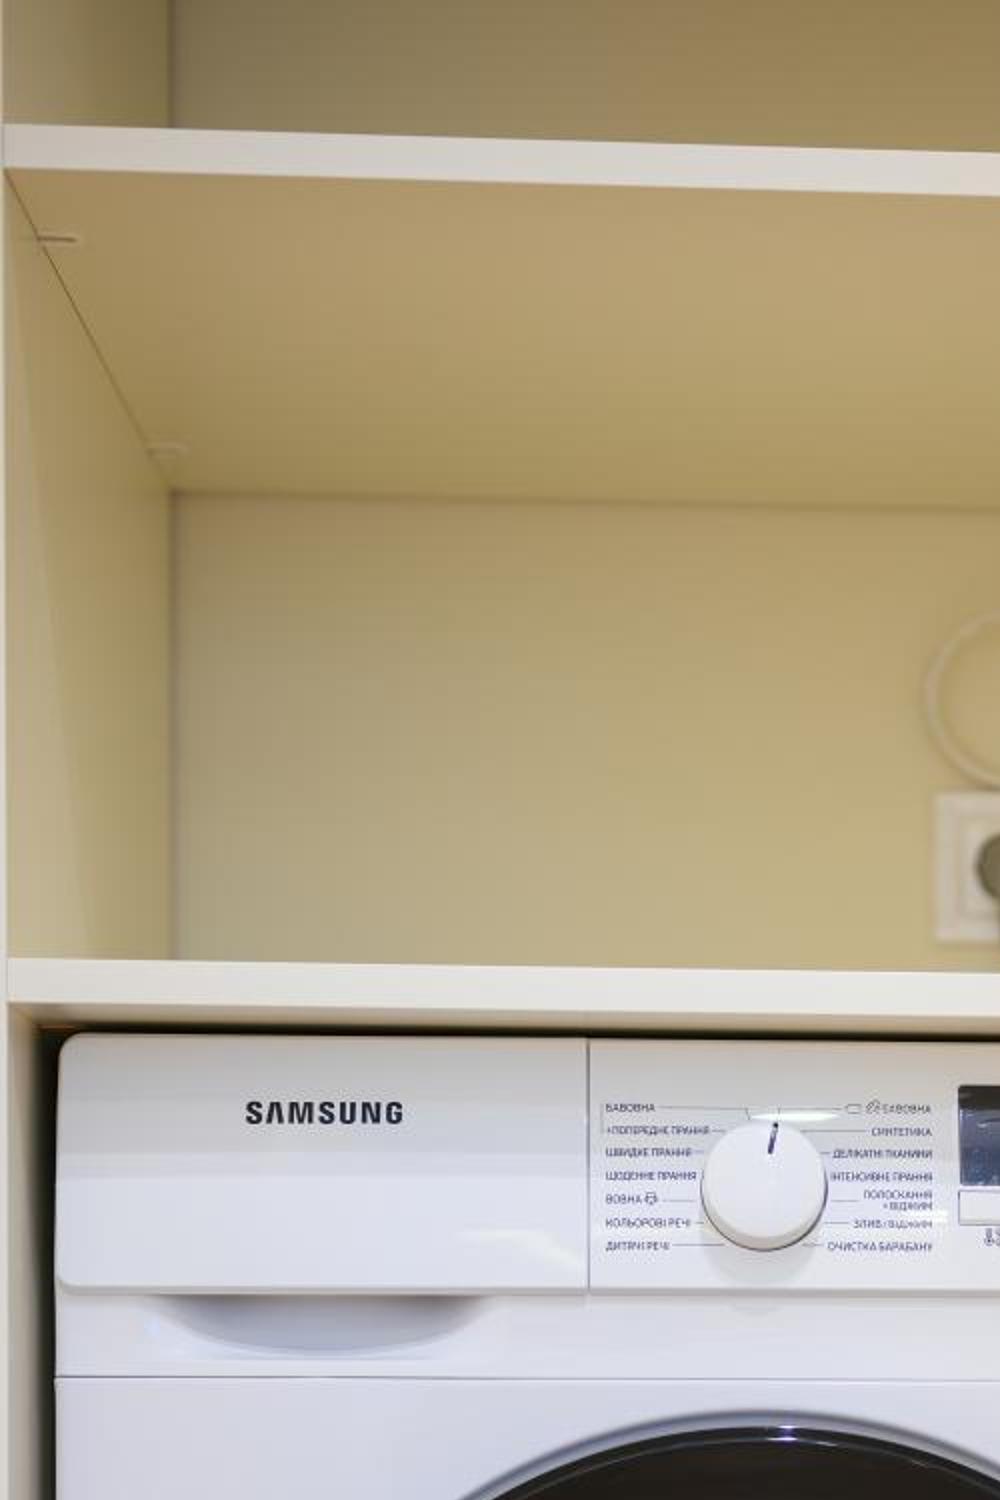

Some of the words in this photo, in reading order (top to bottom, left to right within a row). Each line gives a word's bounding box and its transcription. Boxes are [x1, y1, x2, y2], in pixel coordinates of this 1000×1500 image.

[246, 1101, 403, 1125] SAMSUNG
[605, 1103, 656, 1113] БАВОВНА
[871, 1127, 933, 1136] СИНТЕТИКА
[658, 1171, 697, 1181] ПРАННЯ
[605, 1193, 642, 1205] ВОВНА
